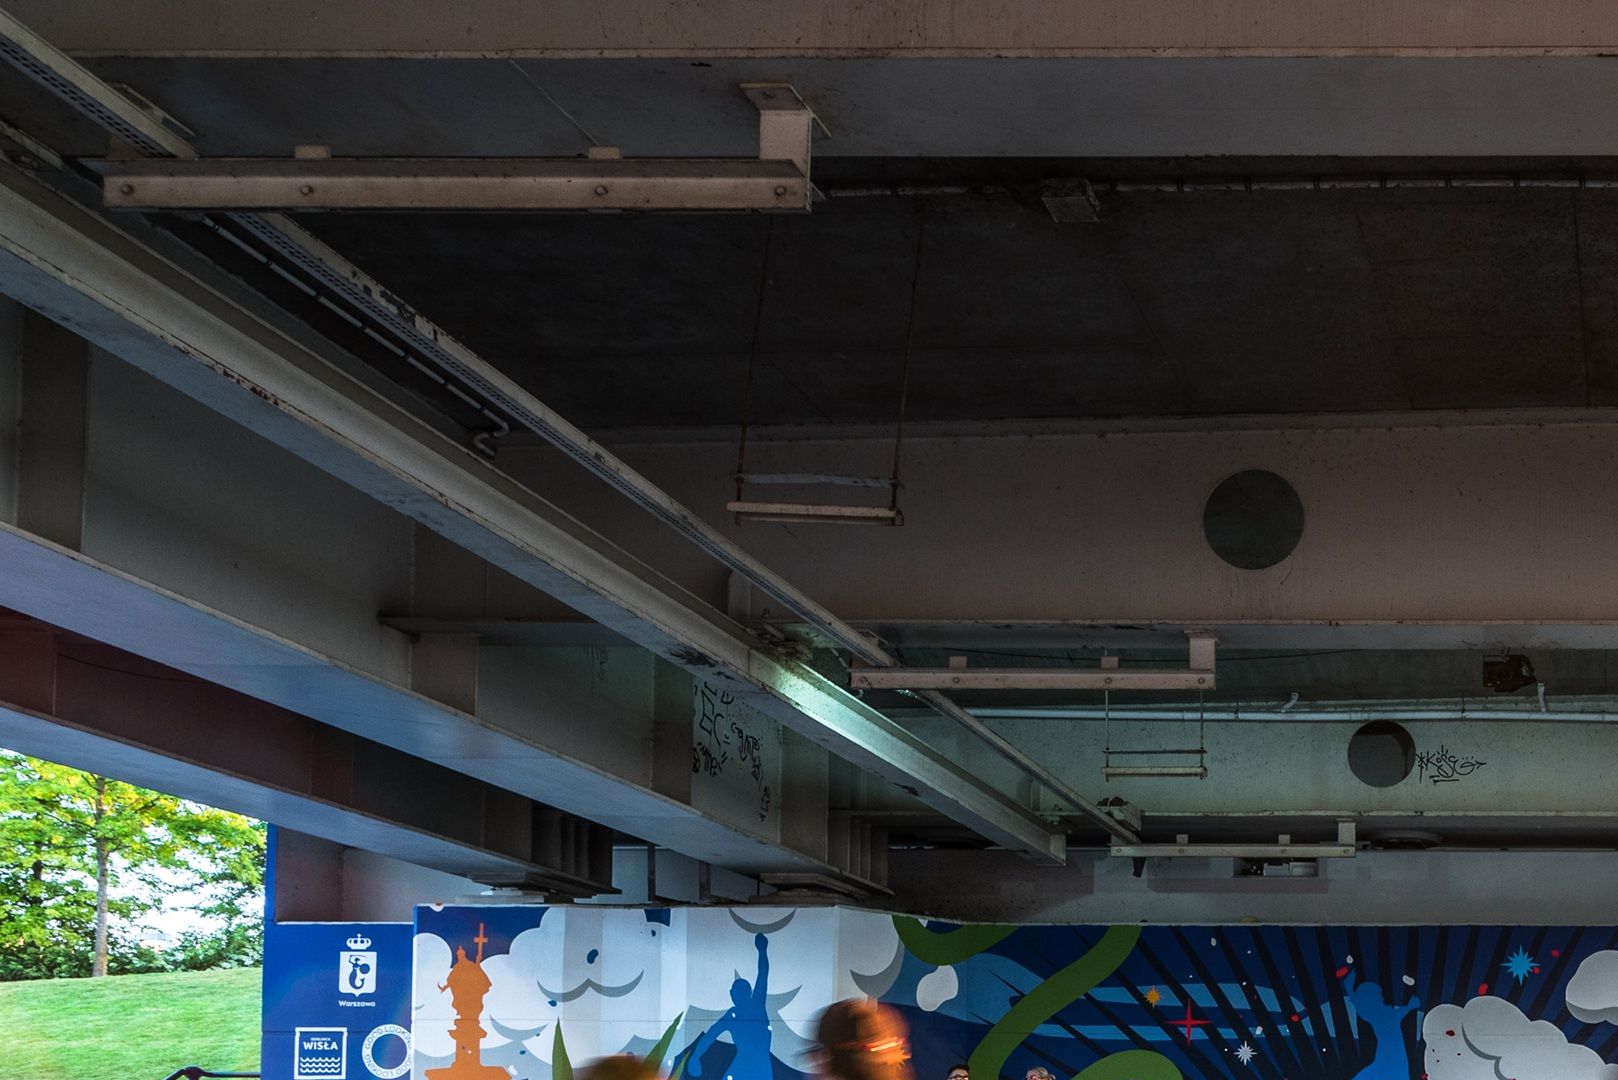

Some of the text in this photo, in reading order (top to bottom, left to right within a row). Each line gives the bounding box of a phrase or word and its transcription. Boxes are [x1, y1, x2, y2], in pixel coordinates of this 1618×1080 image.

[303, 1041, 338, 1050] WISŁA
[364, 1028, 383, 1050] GOOD
[364, 1053, 394, 1078] LOOKING
